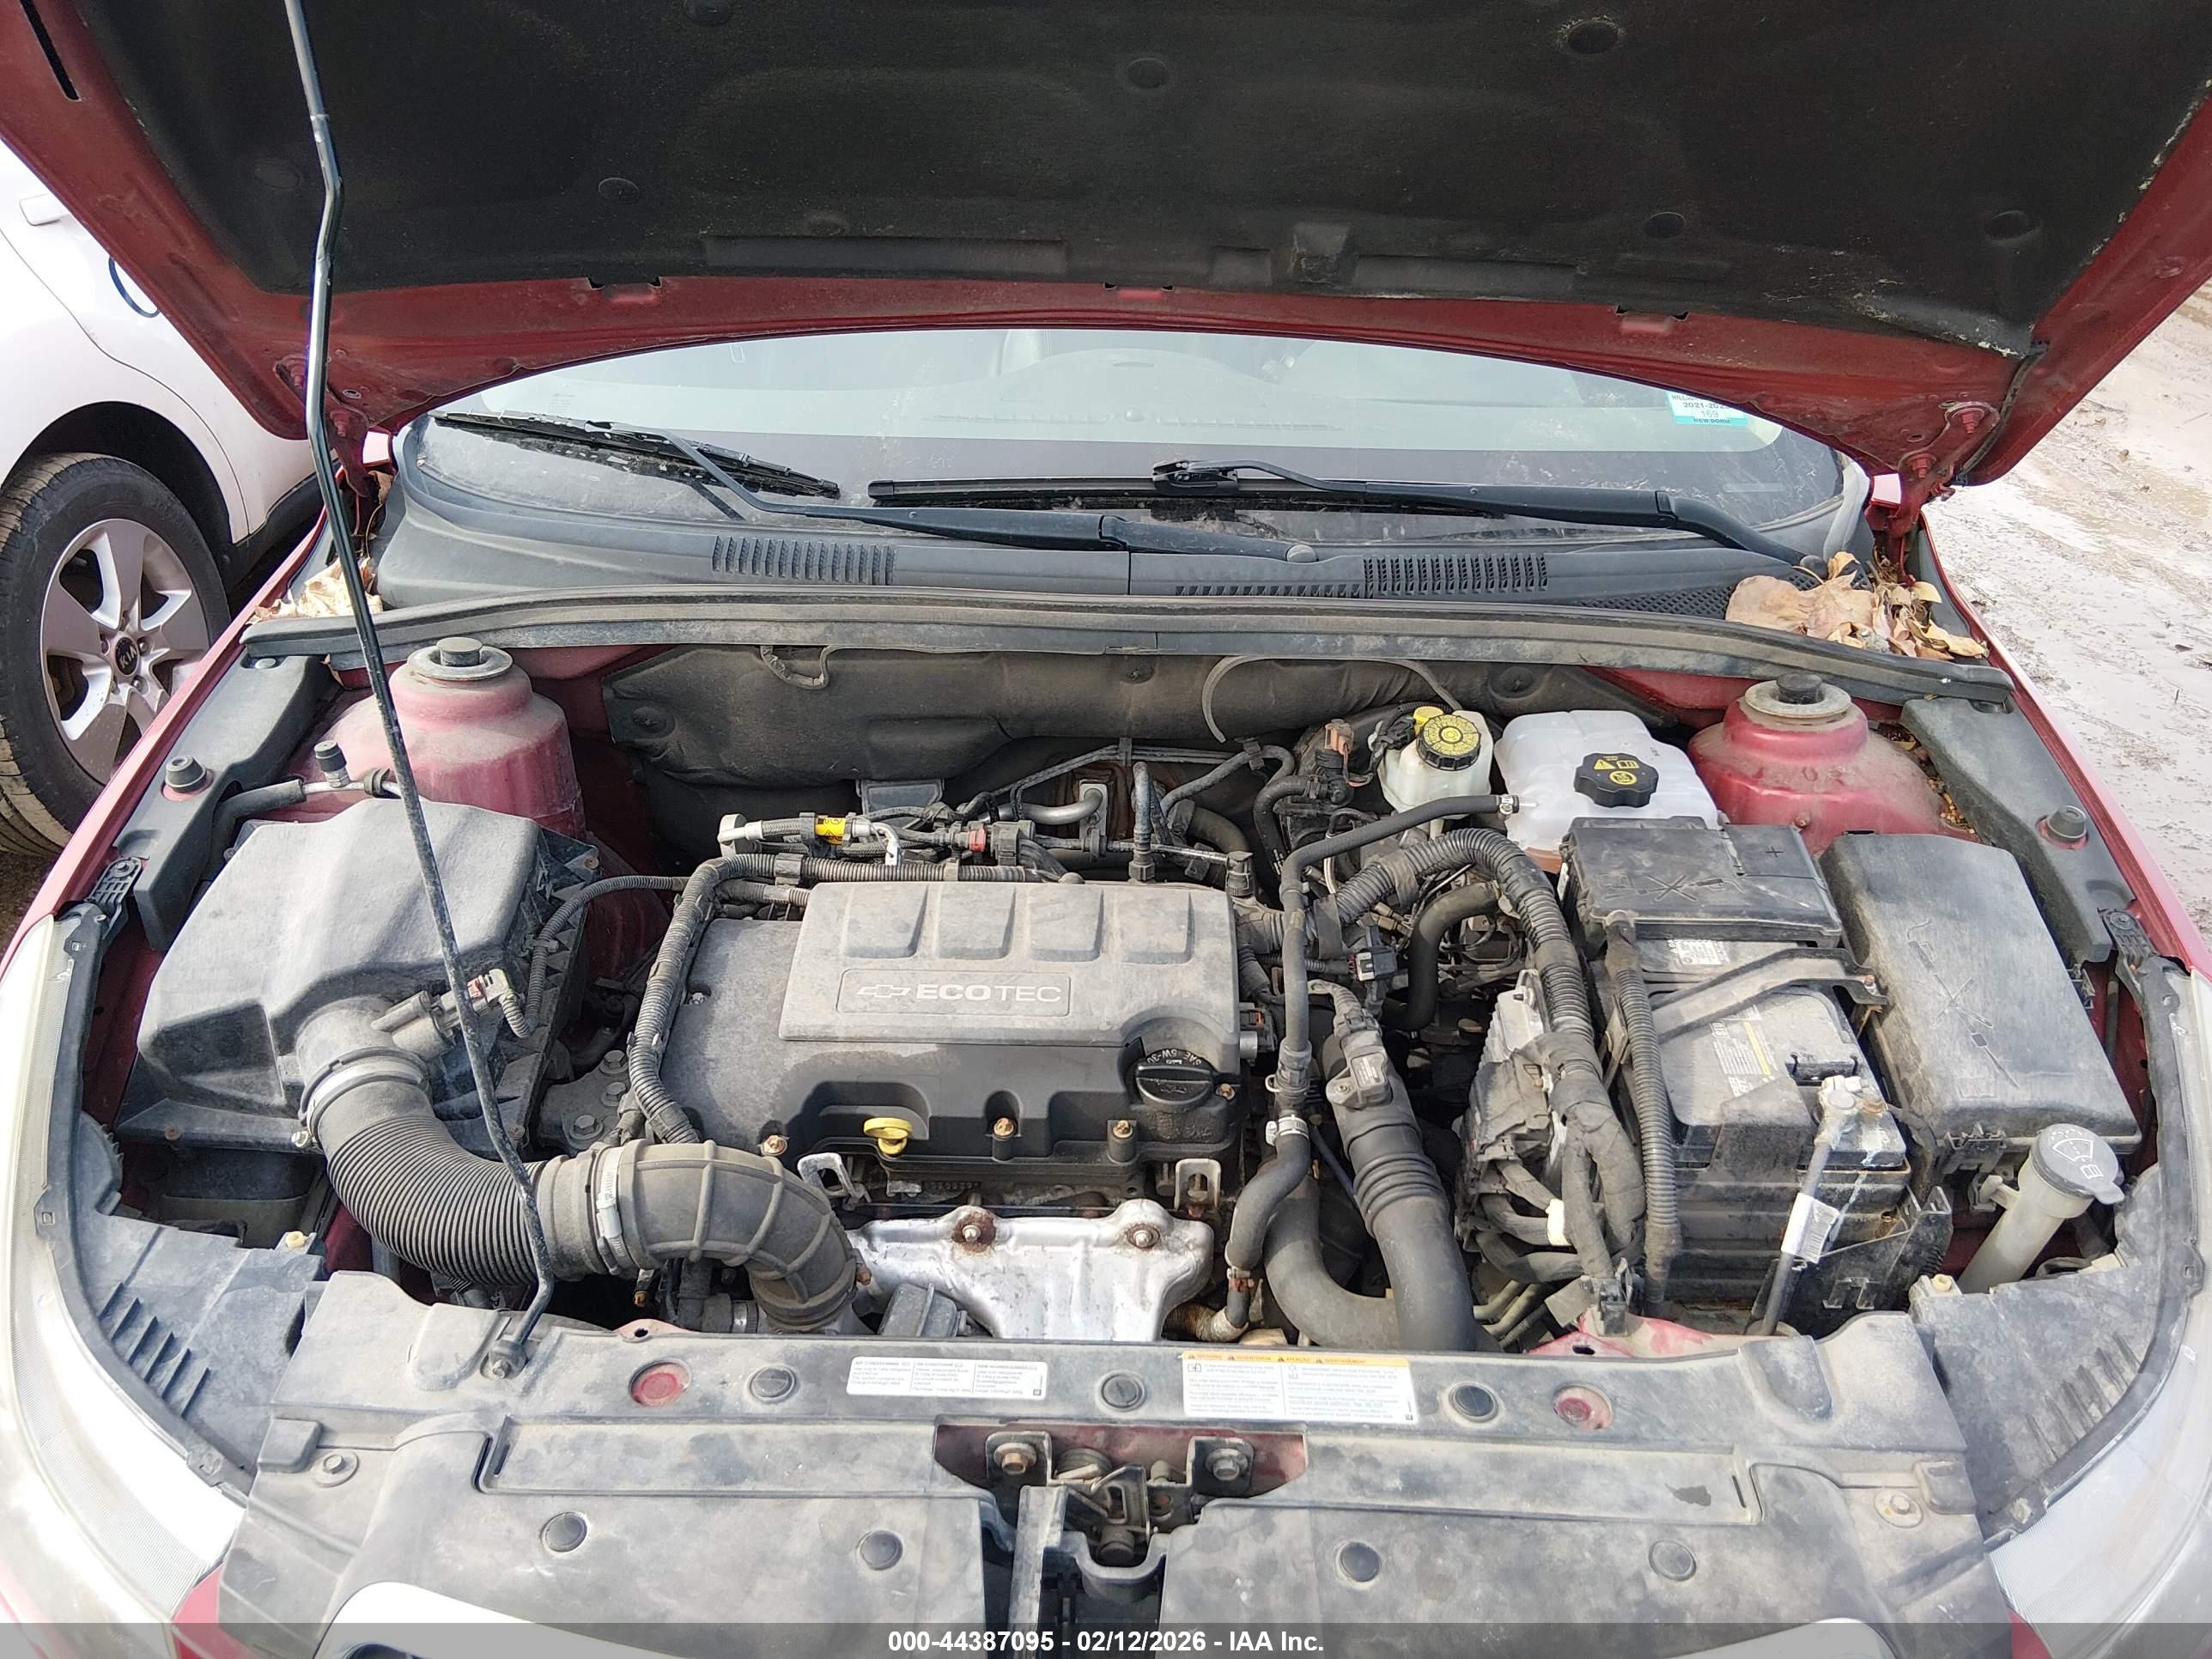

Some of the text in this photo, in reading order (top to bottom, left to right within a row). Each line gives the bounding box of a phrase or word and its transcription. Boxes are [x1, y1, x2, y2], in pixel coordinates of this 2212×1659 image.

[118, 645, 137, 669] KIA
[916, 983, 1061, 1002] ECOTEC
[1183, 1052, 1202, 1066] SAE
